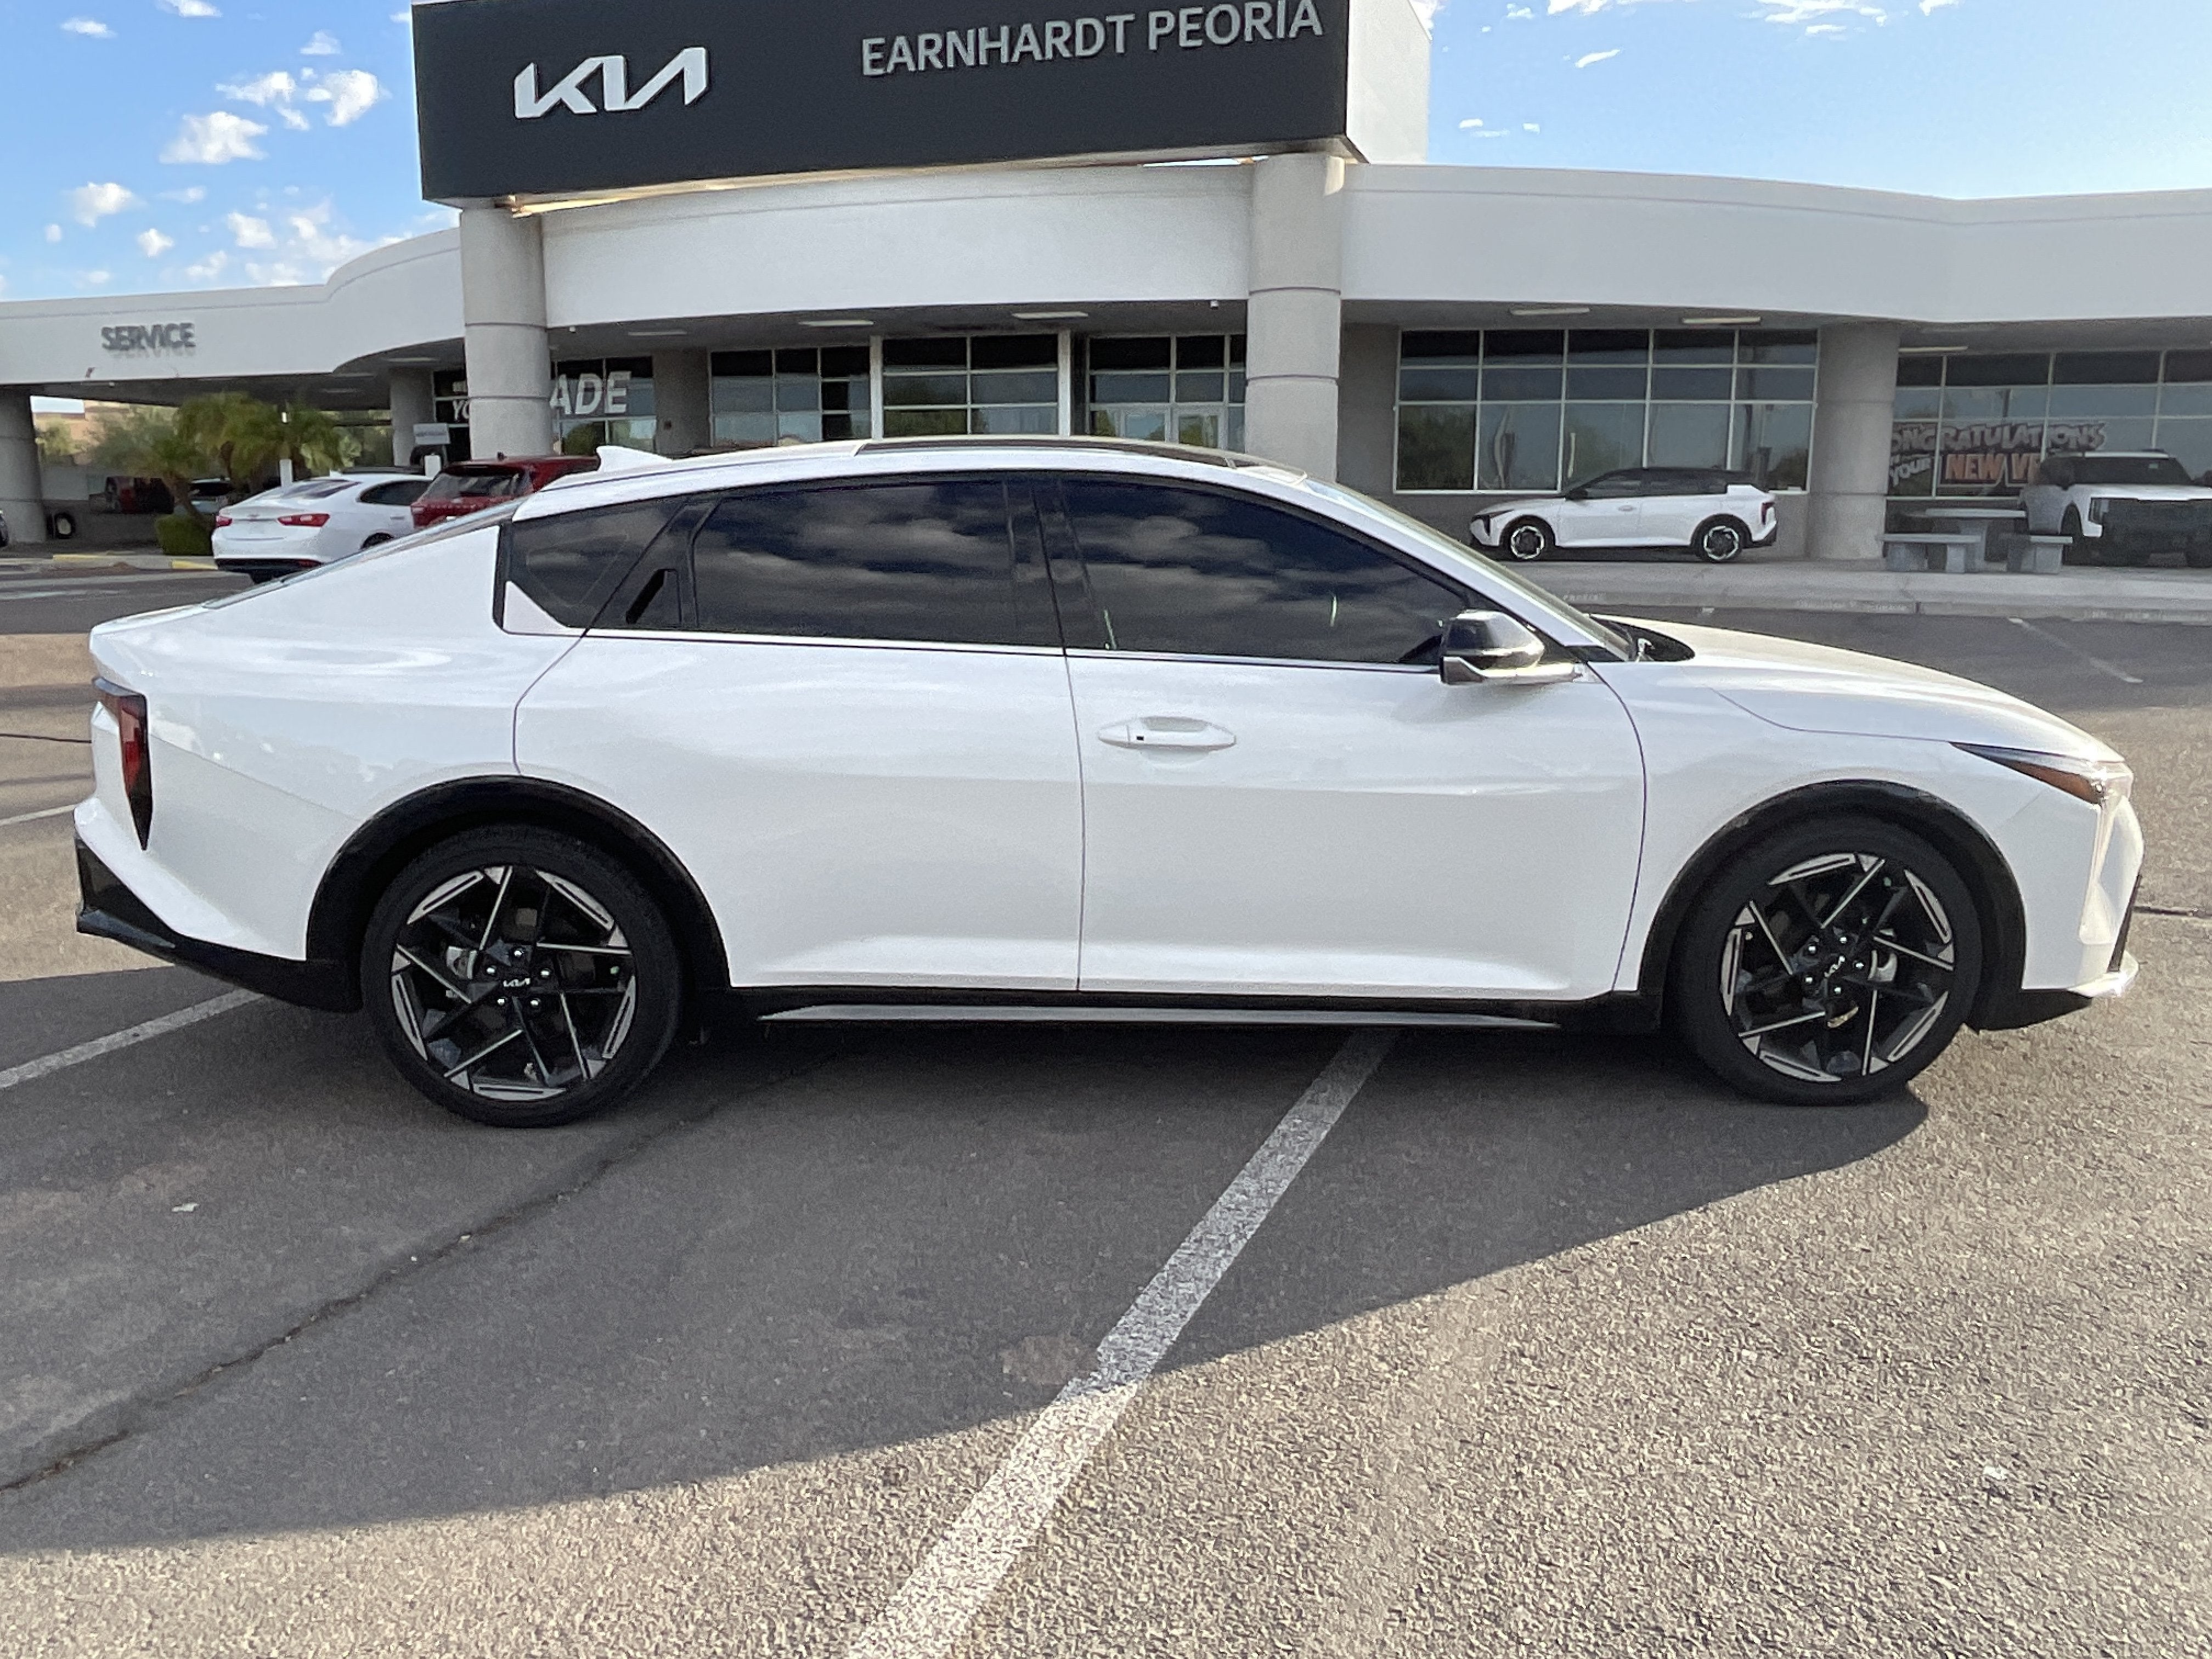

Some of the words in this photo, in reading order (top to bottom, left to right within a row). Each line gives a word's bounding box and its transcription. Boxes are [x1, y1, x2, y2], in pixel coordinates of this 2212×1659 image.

[862, 13, 1135, 76] EARNHARDT
[1148, 0, 1324, 50] PEORIA
[514, 46, 709, 119] KIA
[101, 322, 196, 351] SERVICE
[549, 371, 631, 415] ADE
[452, 399, 470, 421] YO
[1891, 423, 2106, 452] ONGRATULATIONS
[1945, 453, 2007, 481] NEW
